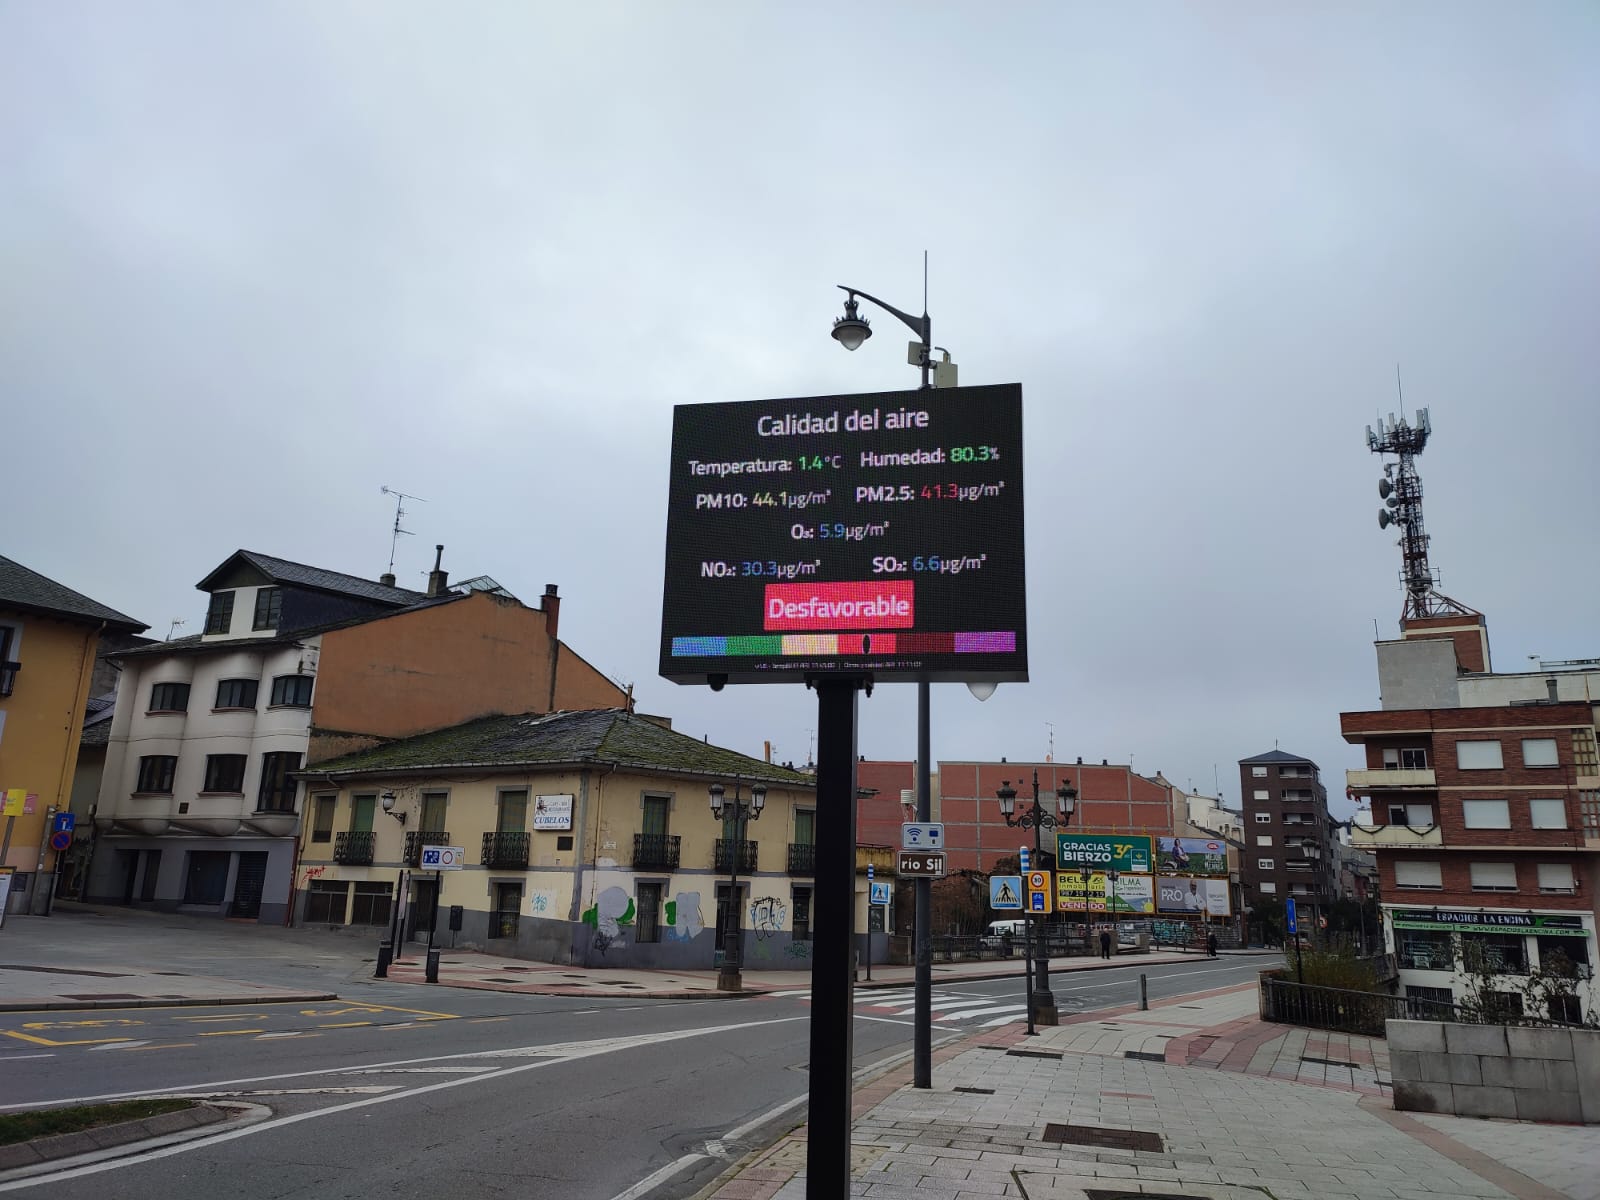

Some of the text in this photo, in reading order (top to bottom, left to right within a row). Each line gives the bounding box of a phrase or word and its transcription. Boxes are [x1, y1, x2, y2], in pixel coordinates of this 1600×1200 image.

[757, 407, 930, 437] Calidad del aire
[860, 445, 1000, 468] Humedad: 80.3%
[688, 458, 792, 478] Temperatura:
[696, 493, 747, 509] PM10:
[856, 486, 915, 503] PM2.5:
[769, 594, 910, 619] Desfavorable
[534, 816, 571, 824] CUBELOS
[1062, 842, 1112, 852] GRACIAS
[1063, 851, 1112, 862] BIERZO
[926, 858, 943, 871] Sil
[1161, 889, 1183, 901] PRO
[1061, 902, 1105, 910] VENDIDO
[1436, 912, 1478, 923] ESPACIOS
[1483, 914, 1496, 923] LA
[1498, 915, 1531, 925] ENCINA
